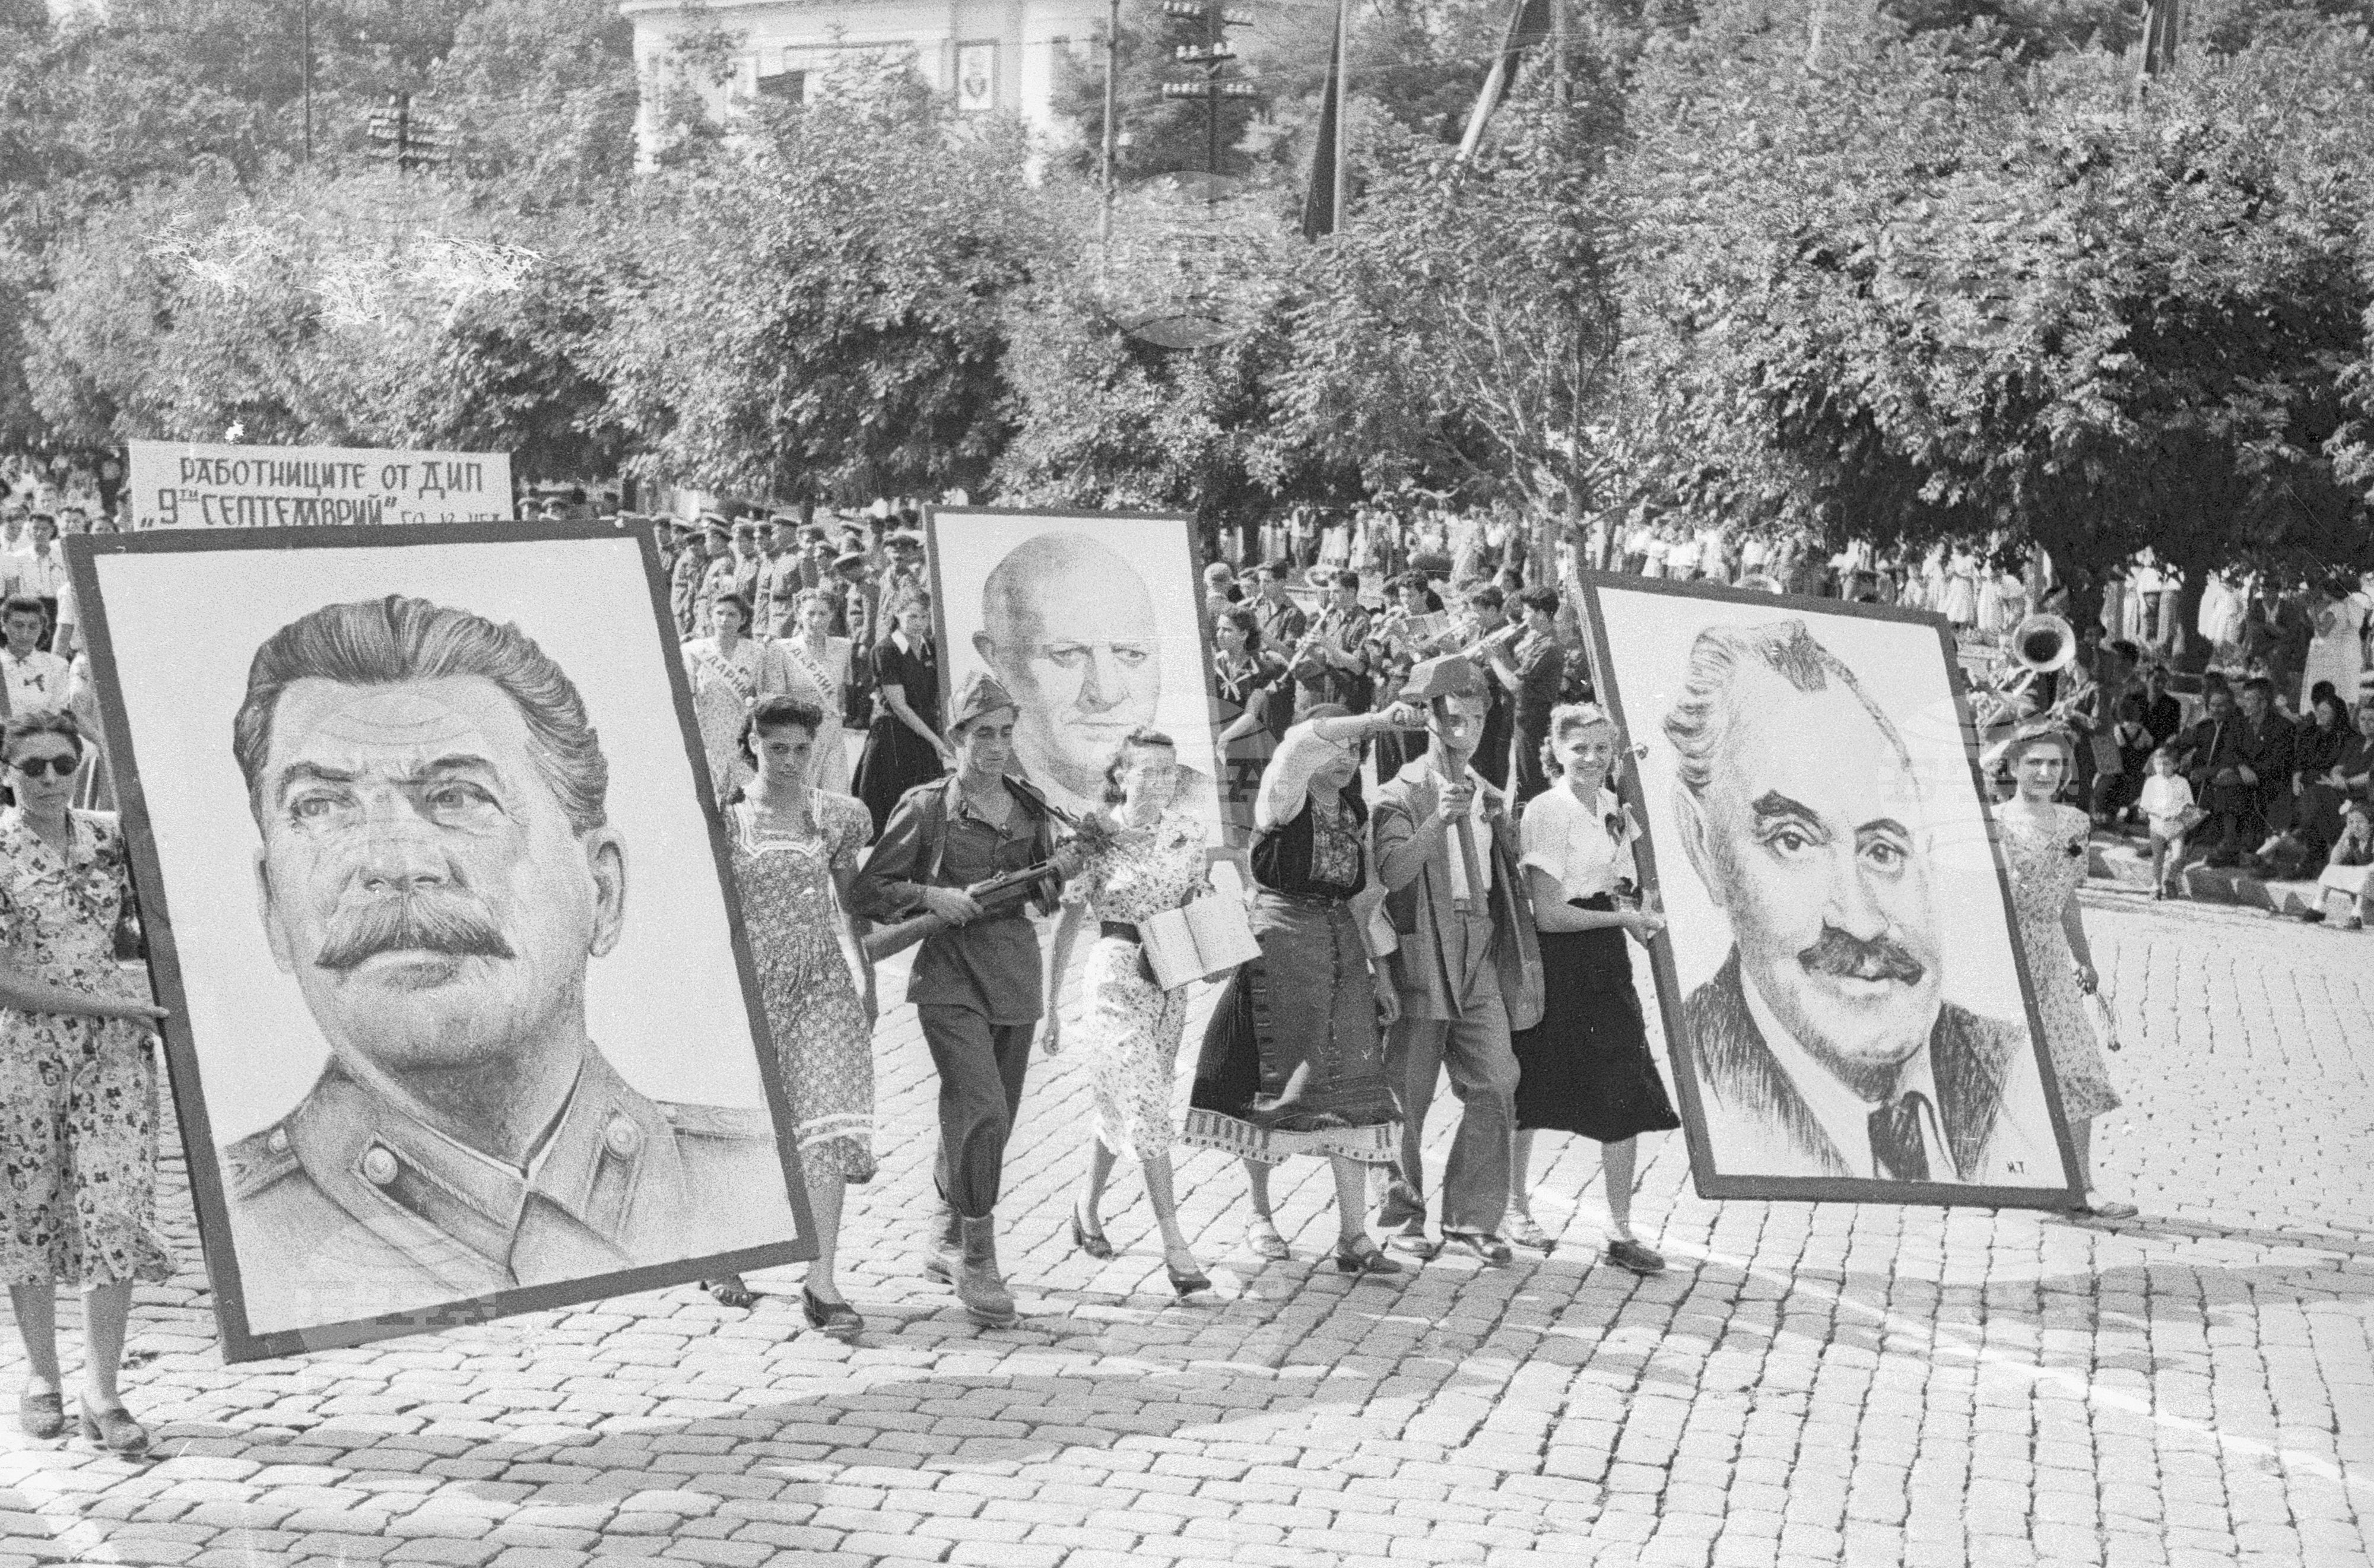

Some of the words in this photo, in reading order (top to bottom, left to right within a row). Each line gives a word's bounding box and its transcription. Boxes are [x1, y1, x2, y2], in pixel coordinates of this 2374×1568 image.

[180, 457, 366, 496] РАБОТНИЦИТЕ
[381, 465, 412, 490] ОТ
[418, 461, 483, 500] ДИП
